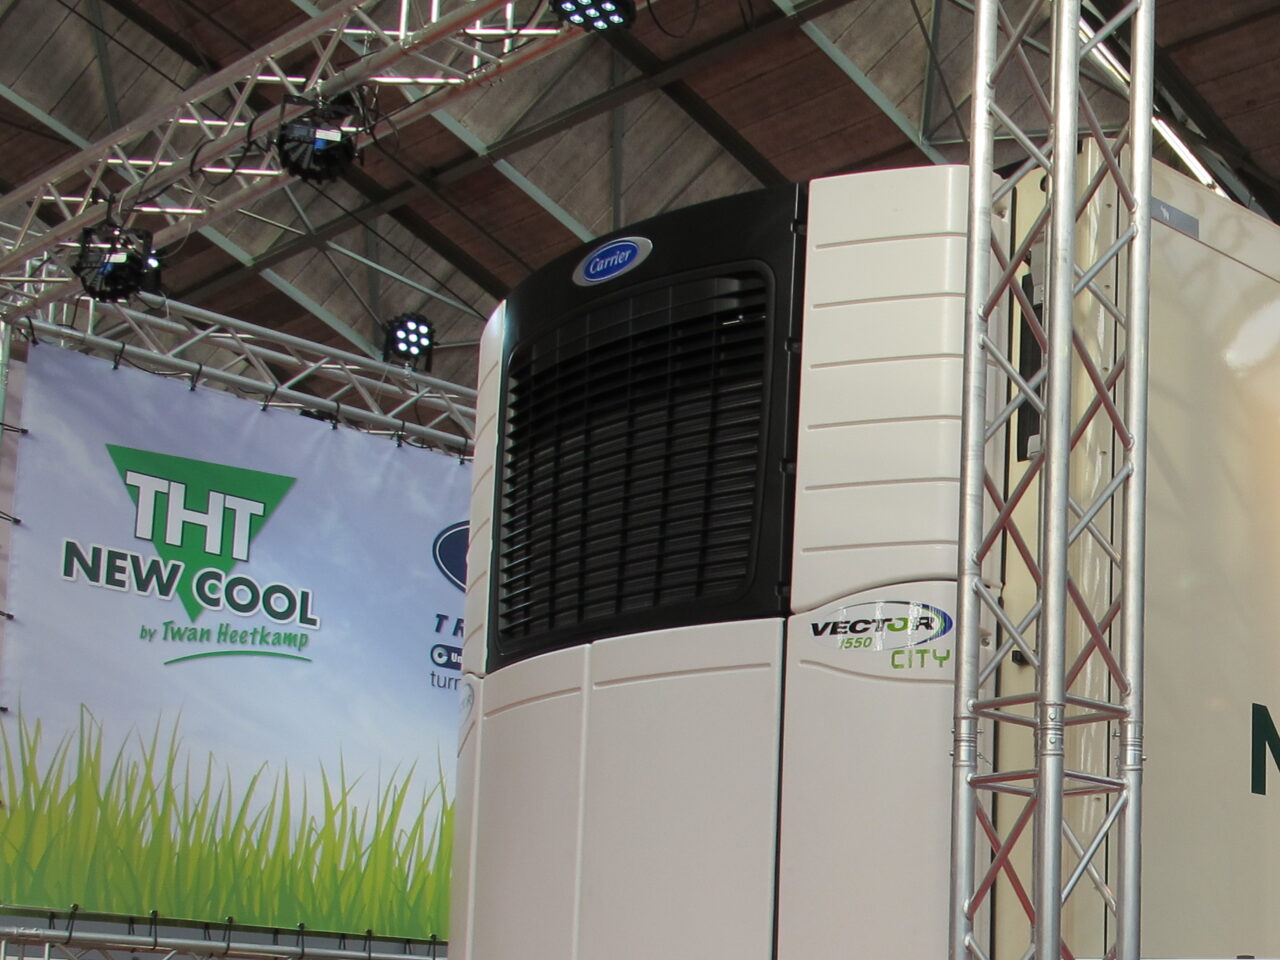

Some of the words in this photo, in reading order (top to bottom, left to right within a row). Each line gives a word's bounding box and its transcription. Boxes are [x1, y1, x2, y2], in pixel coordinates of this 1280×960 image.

[589, 249, 632, 274] Carrier
[124, 469, 266, 562] THT
[62, 540, 183, 598] NEW
[193, 570, 320, 627] COOL
[139, 624, 157, 642] by
[162, 621, 212, 644] Twan
[217, 622, 310, 652] Heetkamp
[811, 616, 935, 637] VECTOR
[840, 637, 873, 650] 1550
[891, 649, 951, 670] CITY
